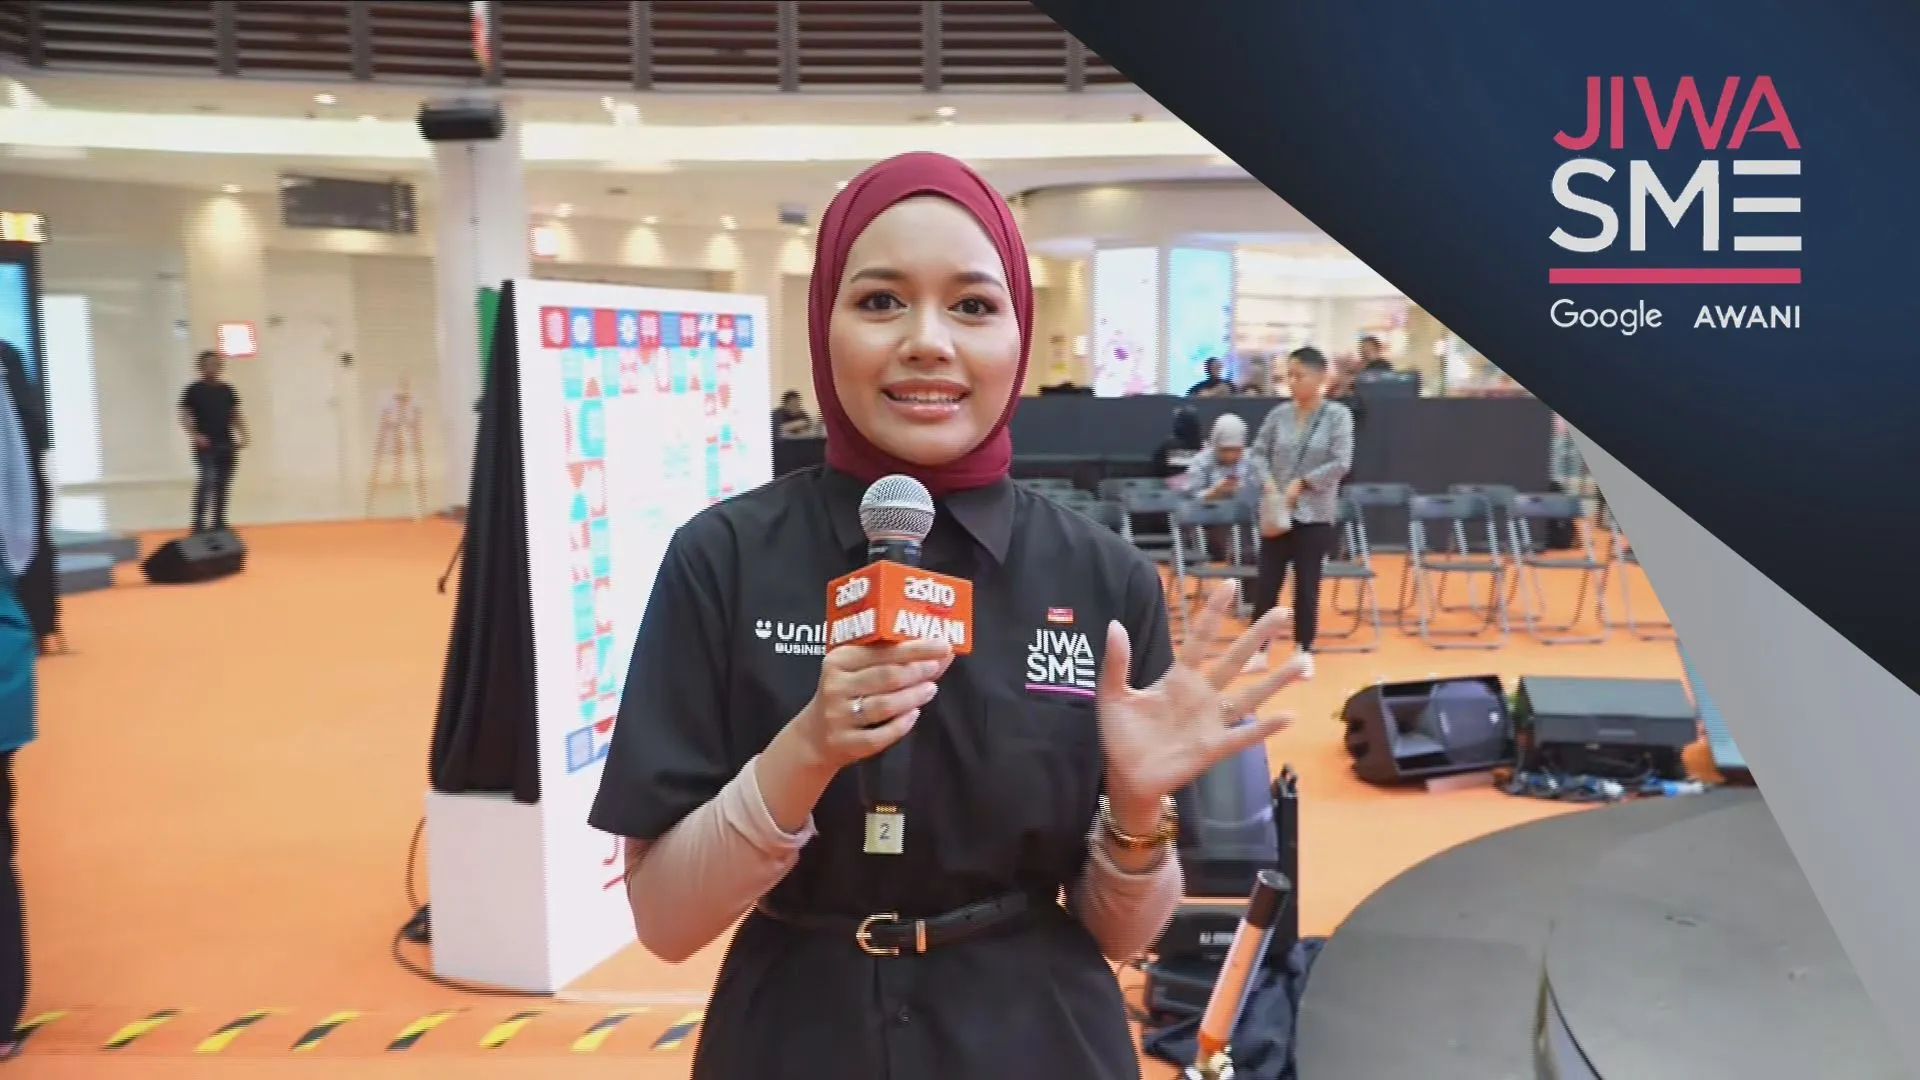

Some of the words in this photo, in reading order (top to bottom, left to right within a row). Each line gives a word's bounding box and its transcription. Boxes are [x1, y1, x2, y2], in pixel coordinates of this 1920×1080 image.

[903, 576, 956, 607] astro
[892, 608, 965, 645] AWANI
[1027, 628, 1094, 658] JIWA
[1026, 652, 1096, 688] SME
[879, 822, 891, 840] 2
